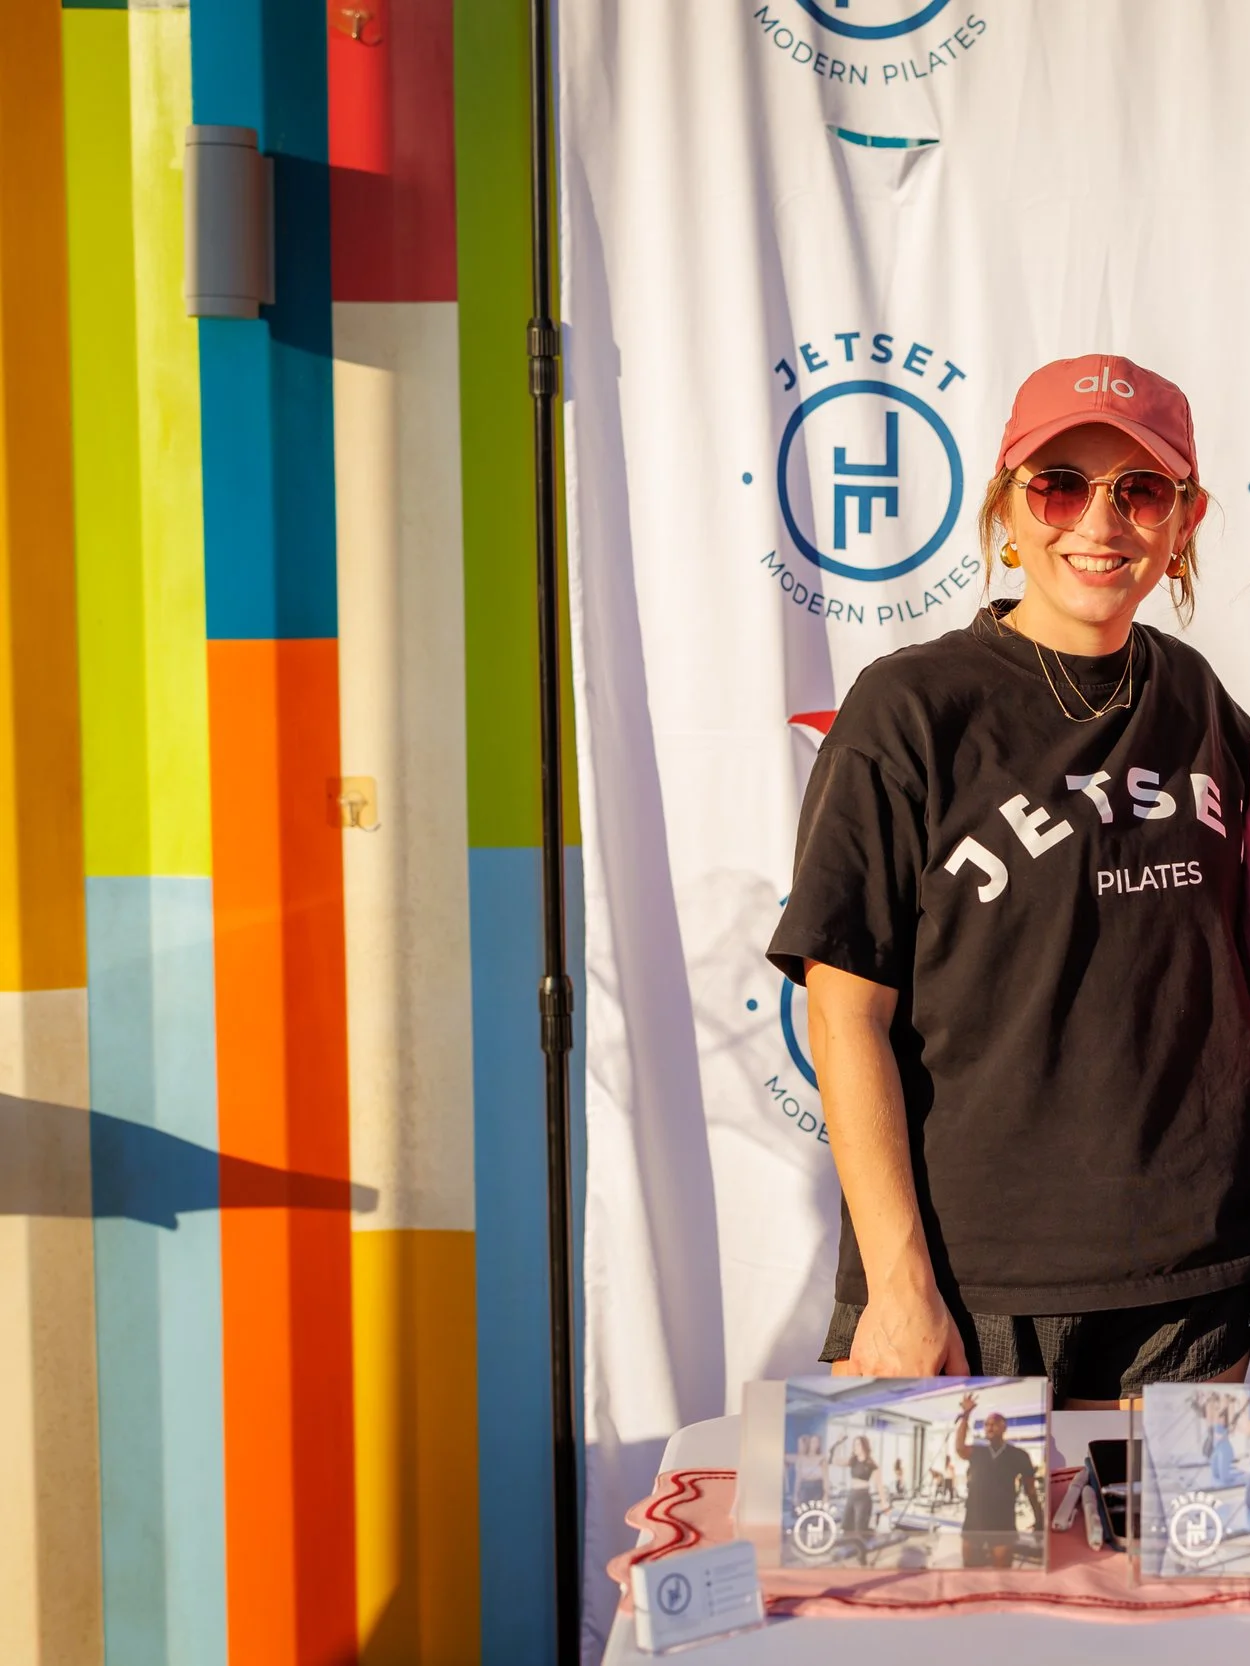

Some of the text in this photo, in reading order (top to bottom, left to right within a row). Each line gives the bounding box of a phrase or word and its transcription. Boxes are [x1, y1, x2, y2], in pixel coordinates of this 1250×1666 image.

[753, 5, 987, 85] MODERN PILATES
[773, 331, 967, 392] JETSET
[1074, 366, 1135, 398] alo
[760, 550, 981, 625] MODERN PILATES
[944, 767, 1244, 903] JETSE
[1097, 861, 1203, 896] PILATES
[764, 1075, 831, 1145] MODE
